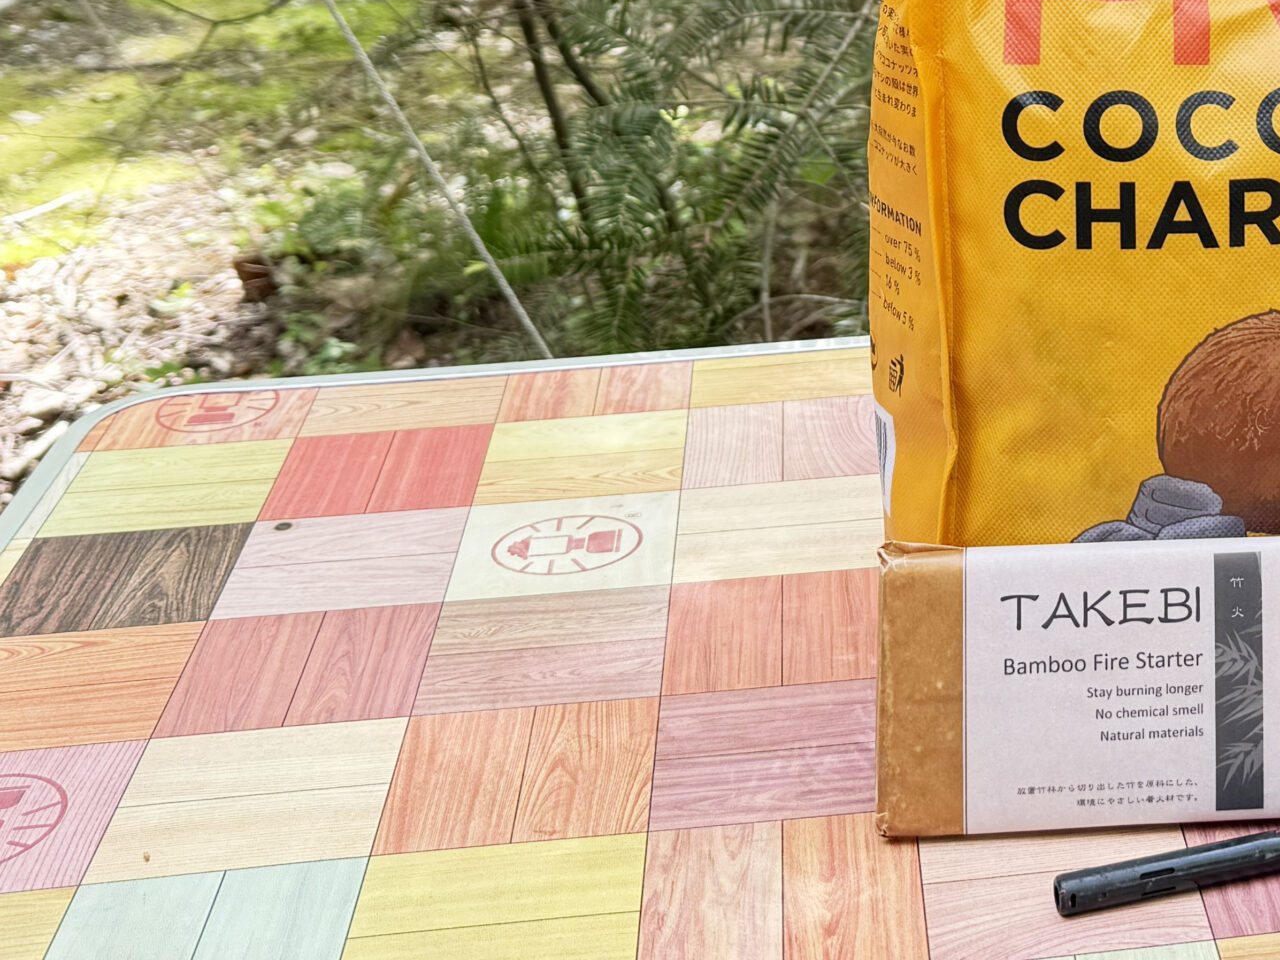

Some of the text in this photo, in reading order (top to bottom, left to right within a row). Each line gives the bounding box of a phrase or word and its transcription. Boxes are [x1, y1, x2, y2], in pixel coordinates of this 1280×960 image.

[870, 191, 922, 237] NFORMATION
[903, 240, 913, 257] 75
[885, 251, 907, 275] below
[907, 266, 913, 280] 3
[883, 298, 901, 321] below
[1000, 586, 1201, 631] TAKEBI
[1003, 651, 1204, 676] Bamboo Fire Starter
[1086, 683, 1204, 700] Stay burning longer
[1095, 703, 1204, 720] No chemical smell
[1100, 726, 1204, 741] Natural materials
